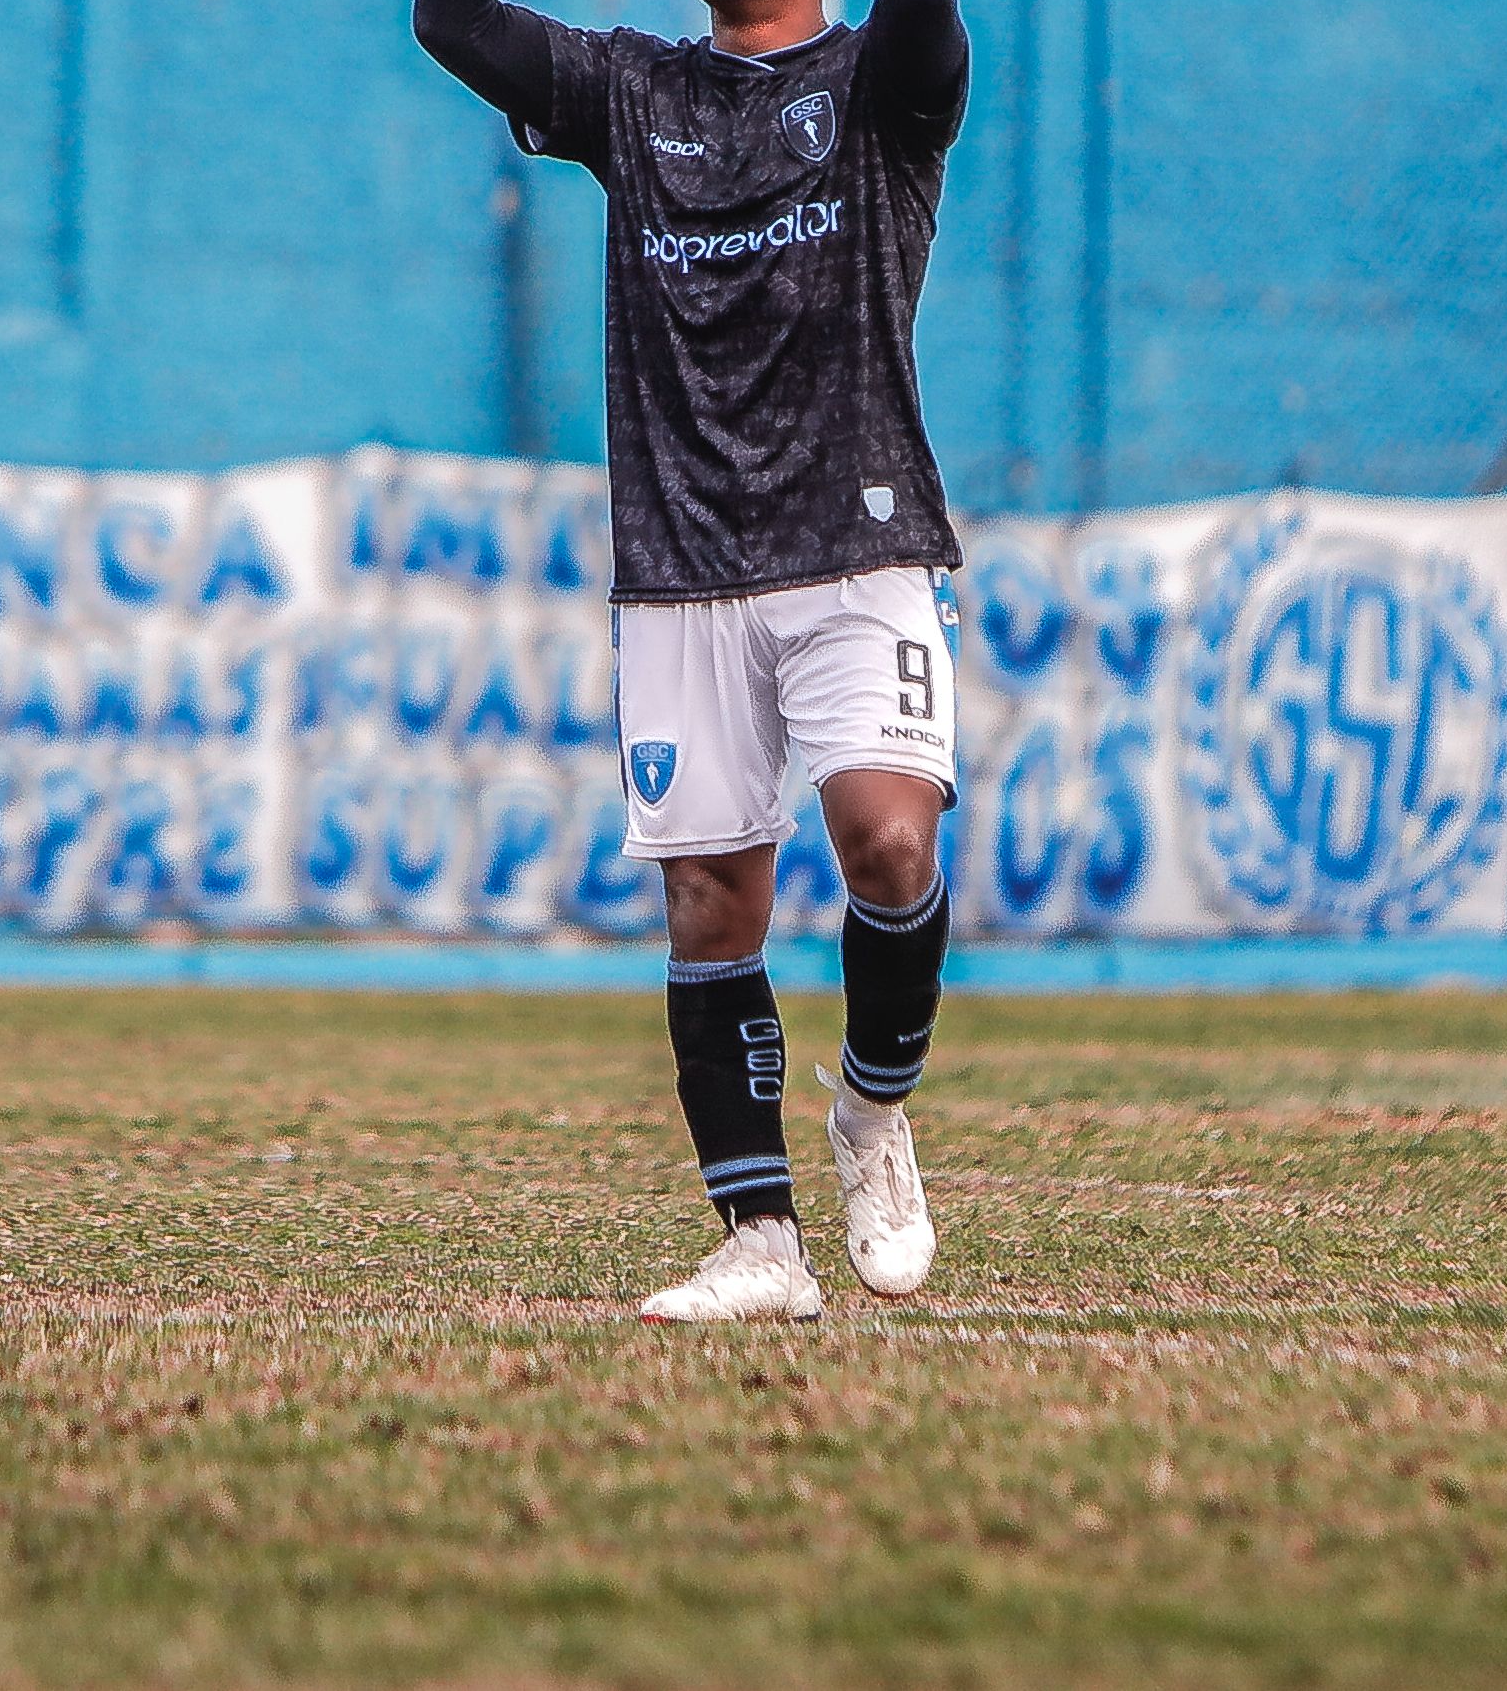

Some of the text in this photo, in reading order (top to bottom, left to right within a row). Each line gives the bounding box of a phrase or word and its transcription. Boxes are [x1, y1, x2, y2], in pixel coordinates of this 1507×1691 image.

[790, 97, 823, 119] GSC
[896, 640, 934, 720] 9
[636, 744, 670, 759] GSC
[739, 1017, 782, 1101] GSC
